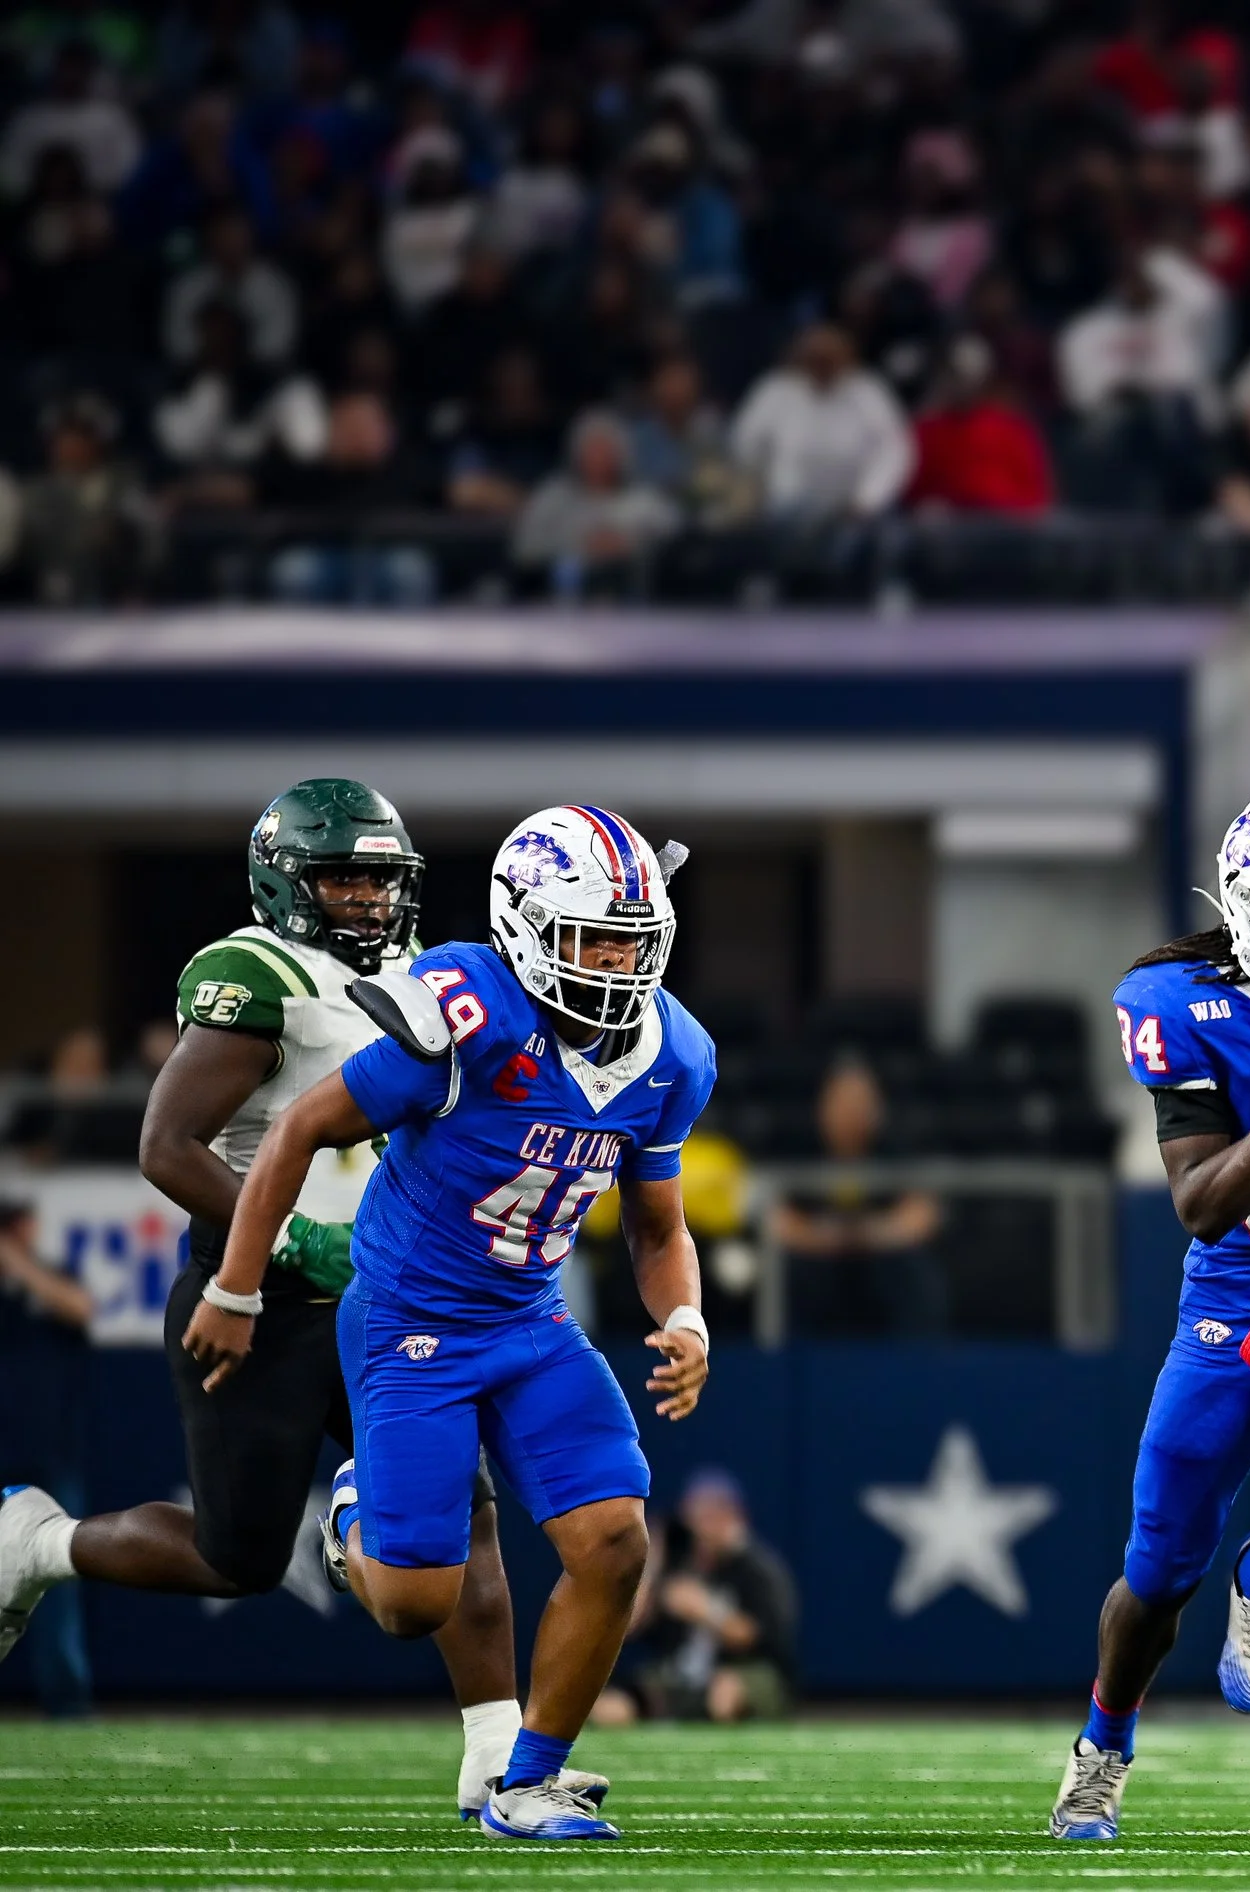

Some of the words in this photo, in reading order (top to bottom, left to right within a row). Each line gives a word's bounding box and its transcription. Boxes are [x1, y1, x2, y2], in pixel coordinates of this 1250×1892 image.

[1188, 999, 1232, 1022] WAO
[524, 1032, 546, 1058] AO
[519, 1122, 566, 1163] CE
[563, 1131, 631, 1169] KING
